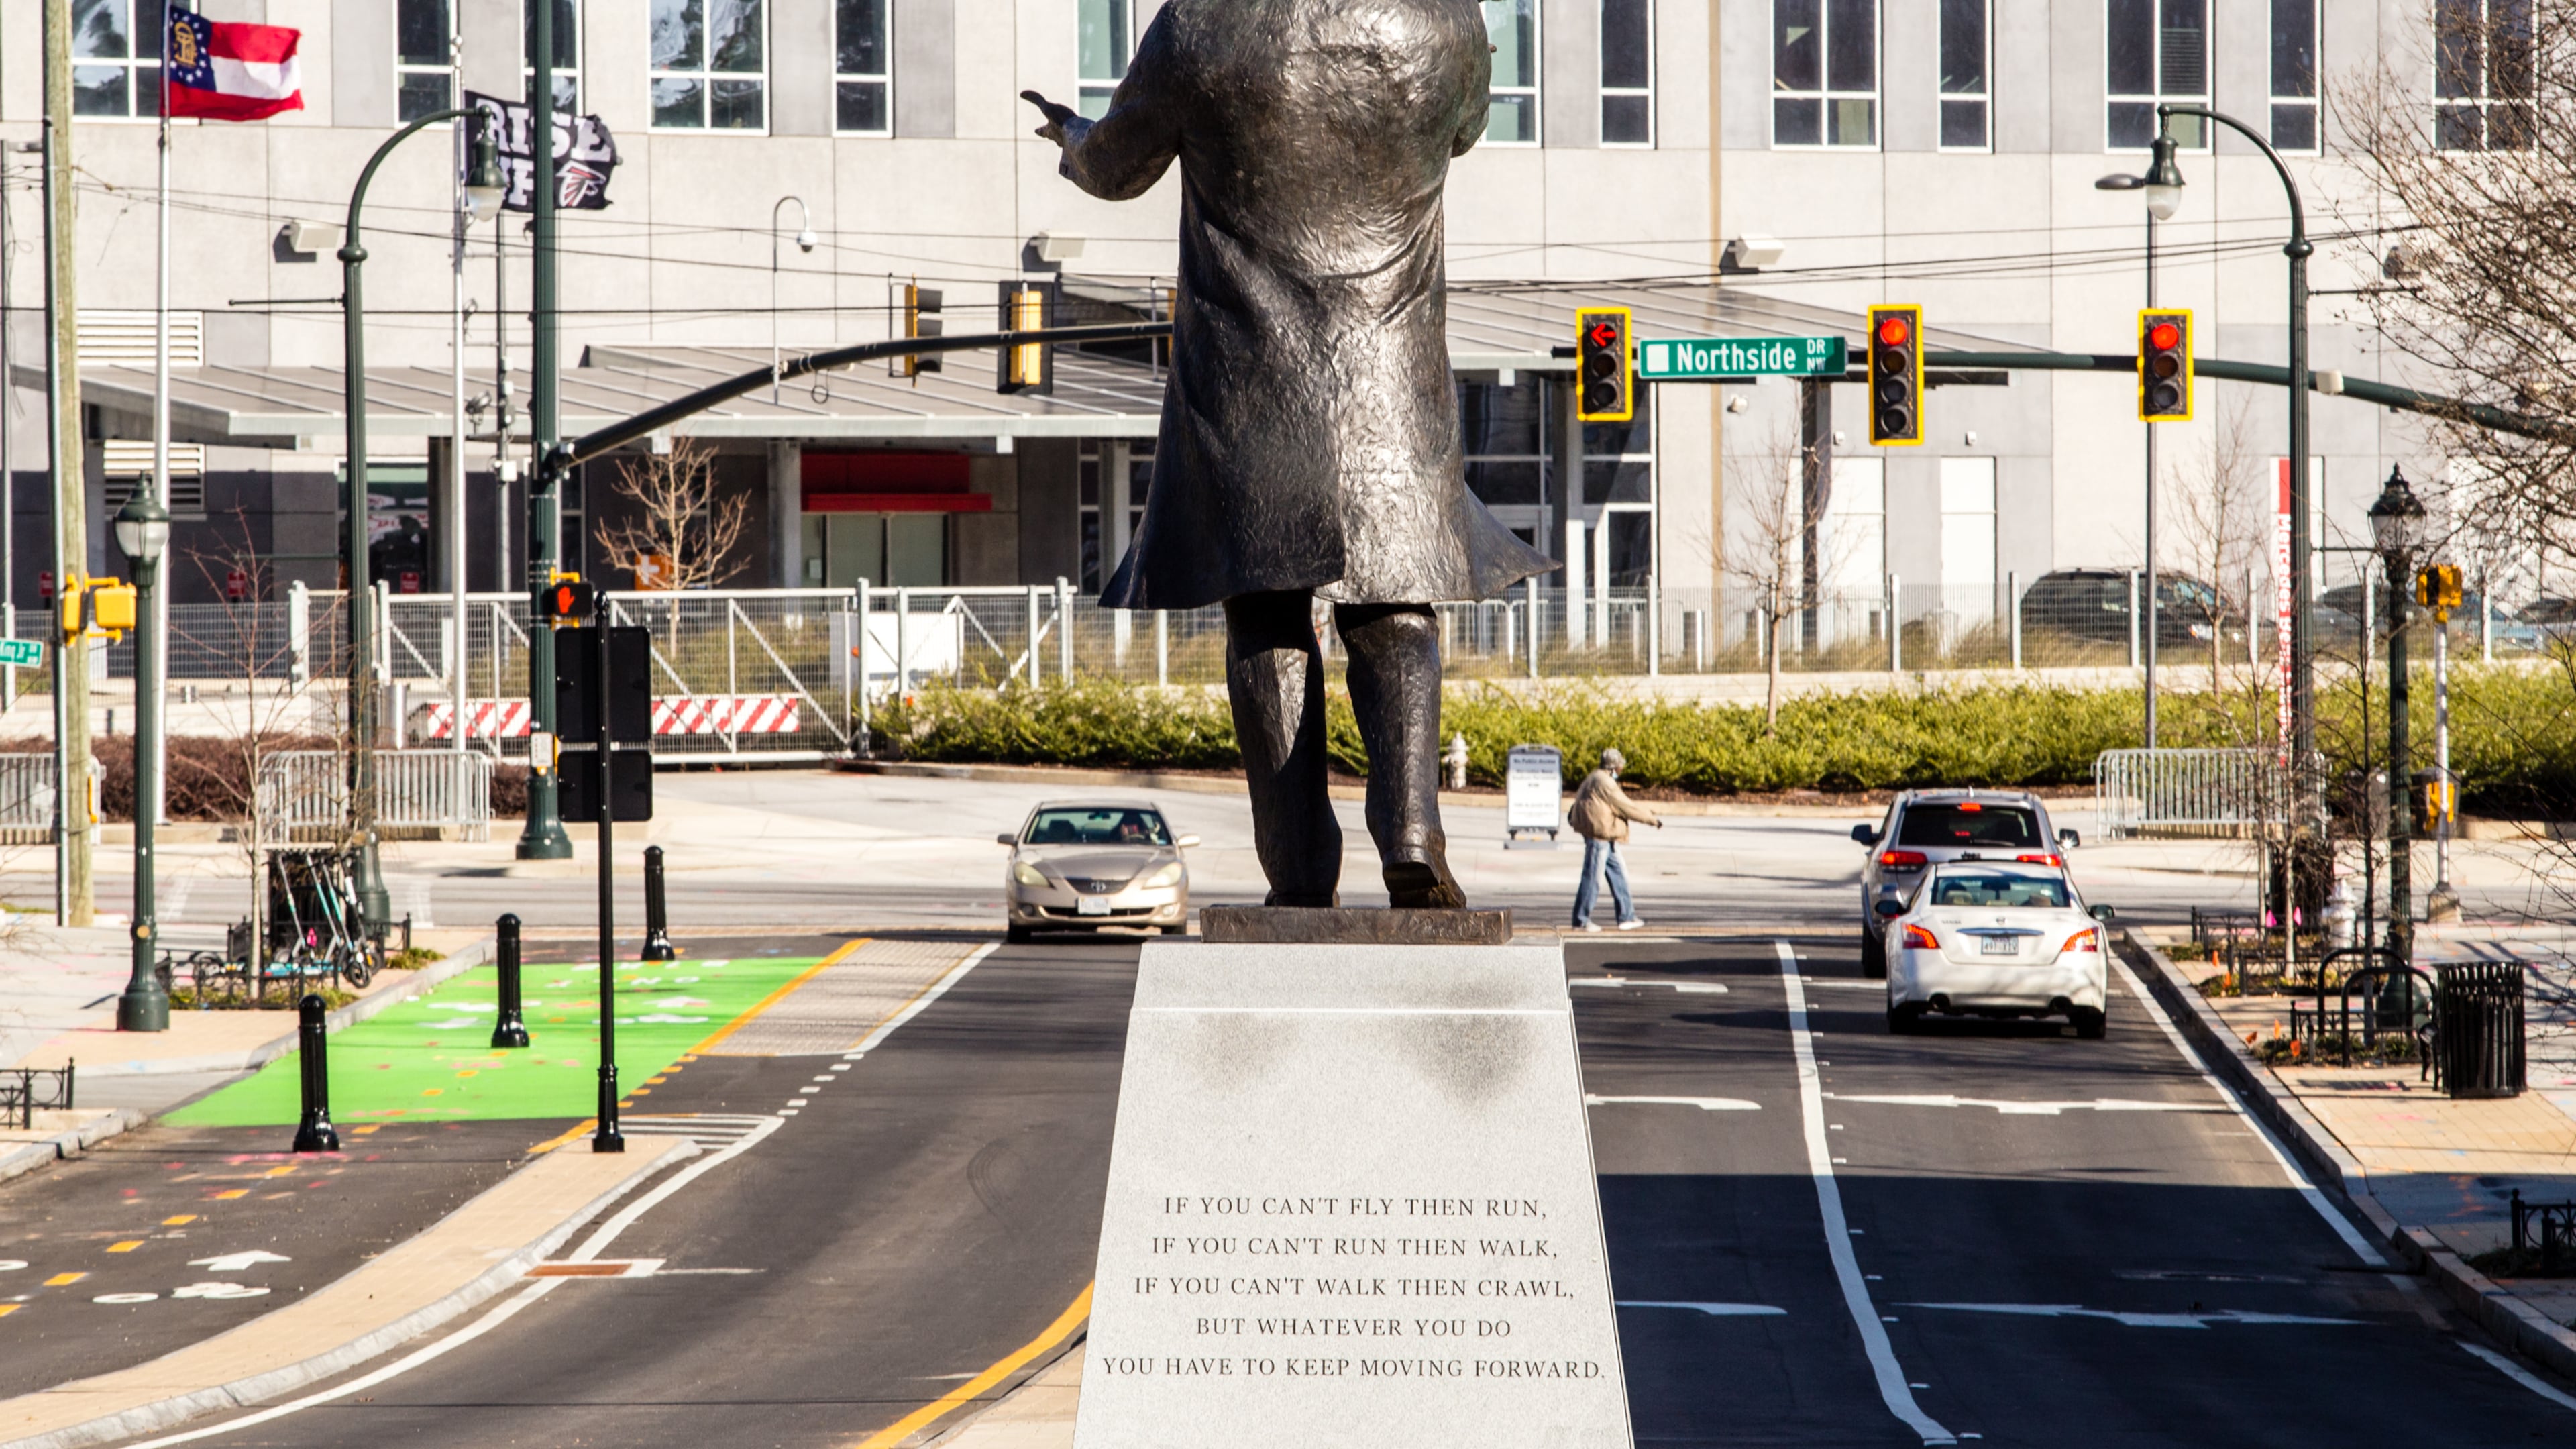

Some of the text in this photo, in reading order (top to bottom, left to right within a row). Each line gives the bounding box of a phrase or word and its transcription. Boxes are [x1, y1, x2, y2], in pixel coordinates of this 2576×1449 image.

[1677, 341, 1797, 373] Northside
[1807, 338, 1826, 355] DR
[1807, 357, 1826, 373] NW
[1165, 1197, 1547, 1220] IF YOU CAN'T FLY THEN RUN,
[1152, 1237, 1558, 1259] IF YOU CAN'T RUN THEN WALK,
[1134, 1277, 1574, 1299] IF YOU CAN'T WALK THEN CRAWL,
[1196, 1318, 1511, 1337] BUT WHATEVER YOU DO
[1102, 1357, 1605, 1379] YOU HAVE TO KEEP MOVING FORWARD.
